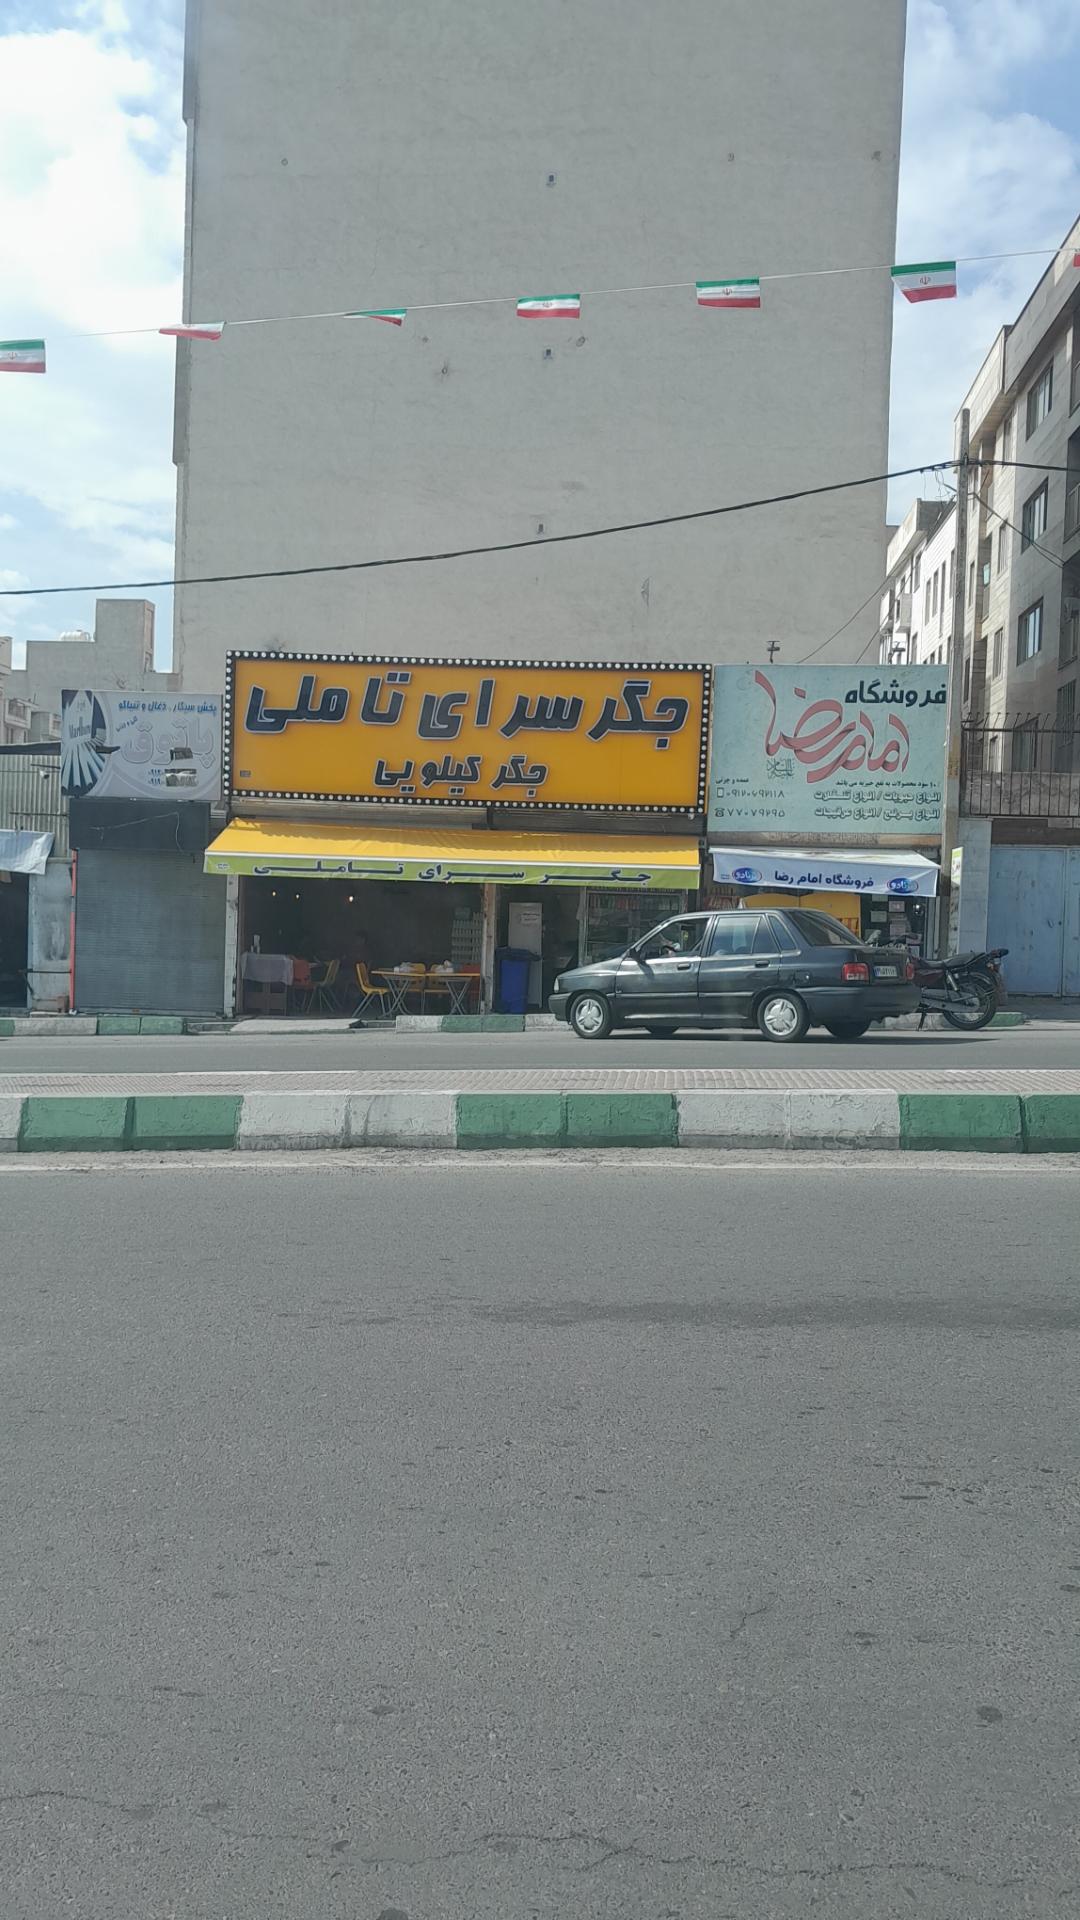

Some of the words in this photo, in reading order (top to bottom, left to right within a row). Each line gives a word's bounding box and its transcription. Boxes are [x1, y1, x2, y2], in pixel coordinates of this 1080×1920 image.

[845, 679, 946, 707] فروشگاه
[586, 679, 690, 750] جگر
[755, 669, 856, 764] رضا
[807, 710, 910, 784] امام
[490, 755, 548, 797] جگر
[852, 790, 875, 804] انواع
[916, 791, 941, 804] انواع
[853, 807, 876, 820] انواع
[915, 808, 940, 821] انواع
[419, 864, 525, 881] سرای
[540, 869, 651, 885] جگر
[774, 870, 794, 884] رضا
[797, 872, 822, 885] امام
[825, 872, 874, 889] فروشگاه
